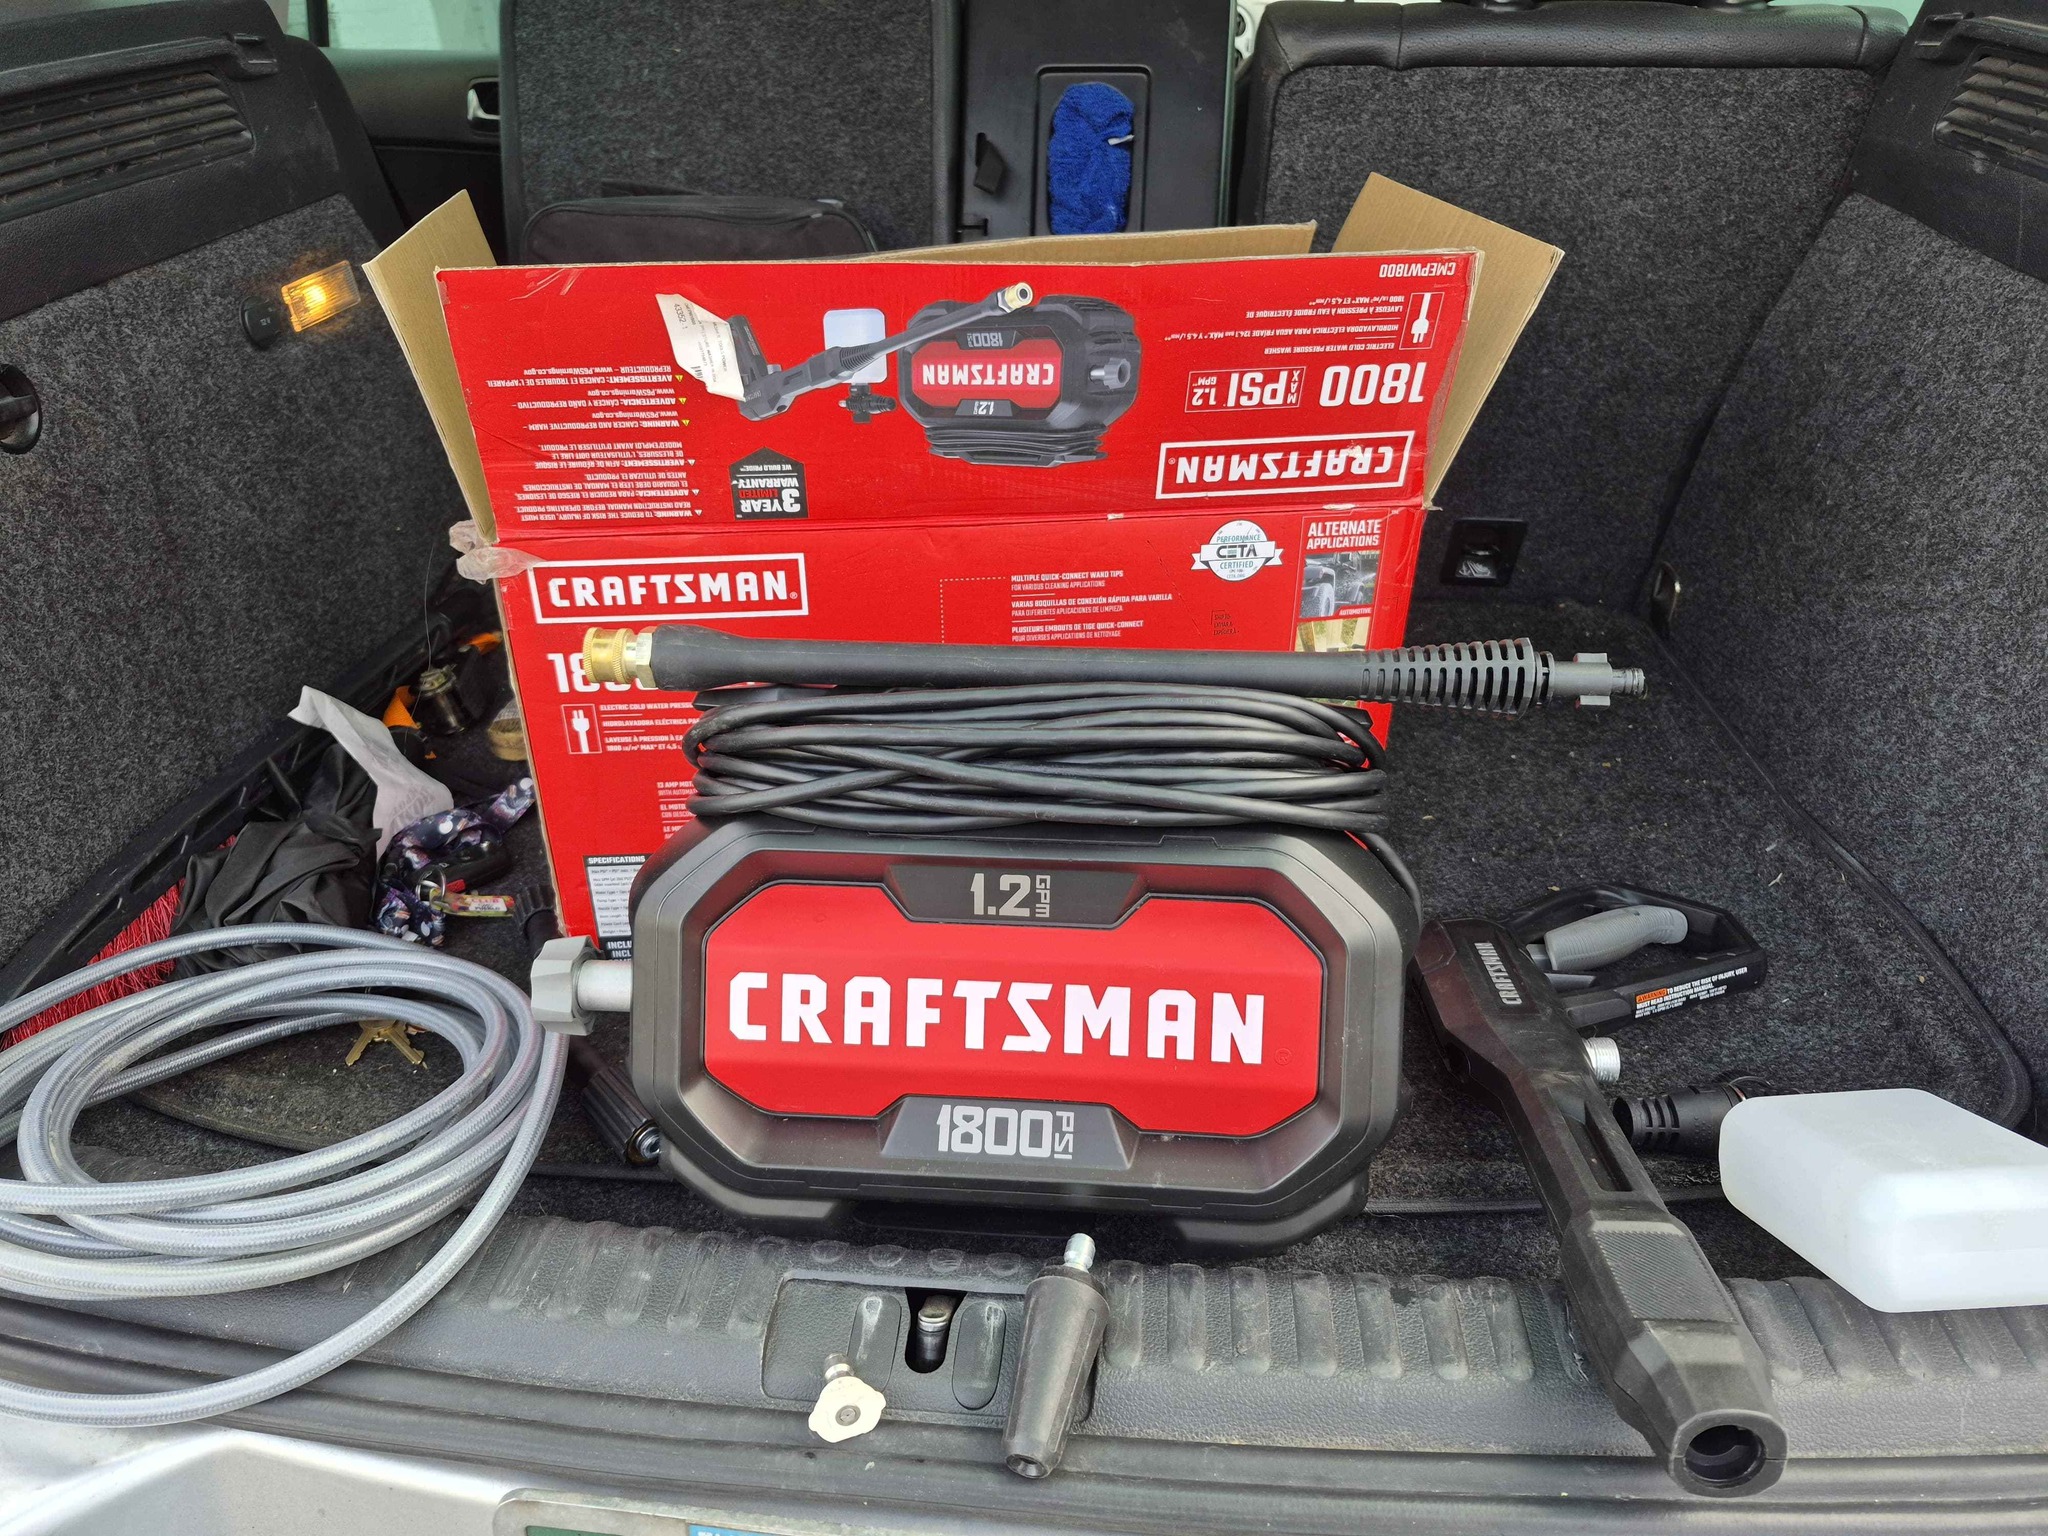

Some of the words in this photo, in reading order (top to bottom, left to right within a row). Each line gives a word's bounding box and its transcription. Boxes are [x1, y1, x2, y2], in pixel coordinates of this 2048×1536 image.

[1379, 262, 1456, 277] CMEPW1800
[1264, 346, 1291, 354] WASHER
[1293, 345, 1324, 353] PRESSURE
[1326, 344, 1348, 352] WATER
[1367, 342, 1394, 350] ELECTRIC
[923, 364, 1054, 385] CRAFTSMAN
[1319, 362, 1427, 406] 1800
[1192, 388, 1217, 405] 1.2
[738, 478, 799, 488] WARRANTY
[739, 489, 778, 498] LIMITED
[740, 499, 782, 512] YEAR
[782, 489, 800, 512] 3
[1308, 520, 1382, 537] ALTERNATE
[1217, 534, 1260, 542] PERFORMANCE
[1306, 535, 1379, 549] APPLICATIONS
[1216, 544, 1257, 558] CETA
[1220, 561, 1253, 569] CERTIFIED
[1011, 574, 1040, 582] MULTIPLE
[1041, 572, 1089, 580] QUICK-CONNECT
[1077, 596, 1106, 604] CONEXIÓN
[1108, 595, 1130, 603] RÁPIDA
[588, 856, 645, 864] SPECIFICATIONS
[970, 873, 1031, 917] 1.2
[1036, 875, 1050, 918] GPM
[1474, 942, 1522, 1004] CRAFTSMAN
[728, 972, 1266, 1064] CRAFTSMAN
[936, 1104, 1053, 1158] 1800
[1054, 1110, 1074, 1160] PSI
